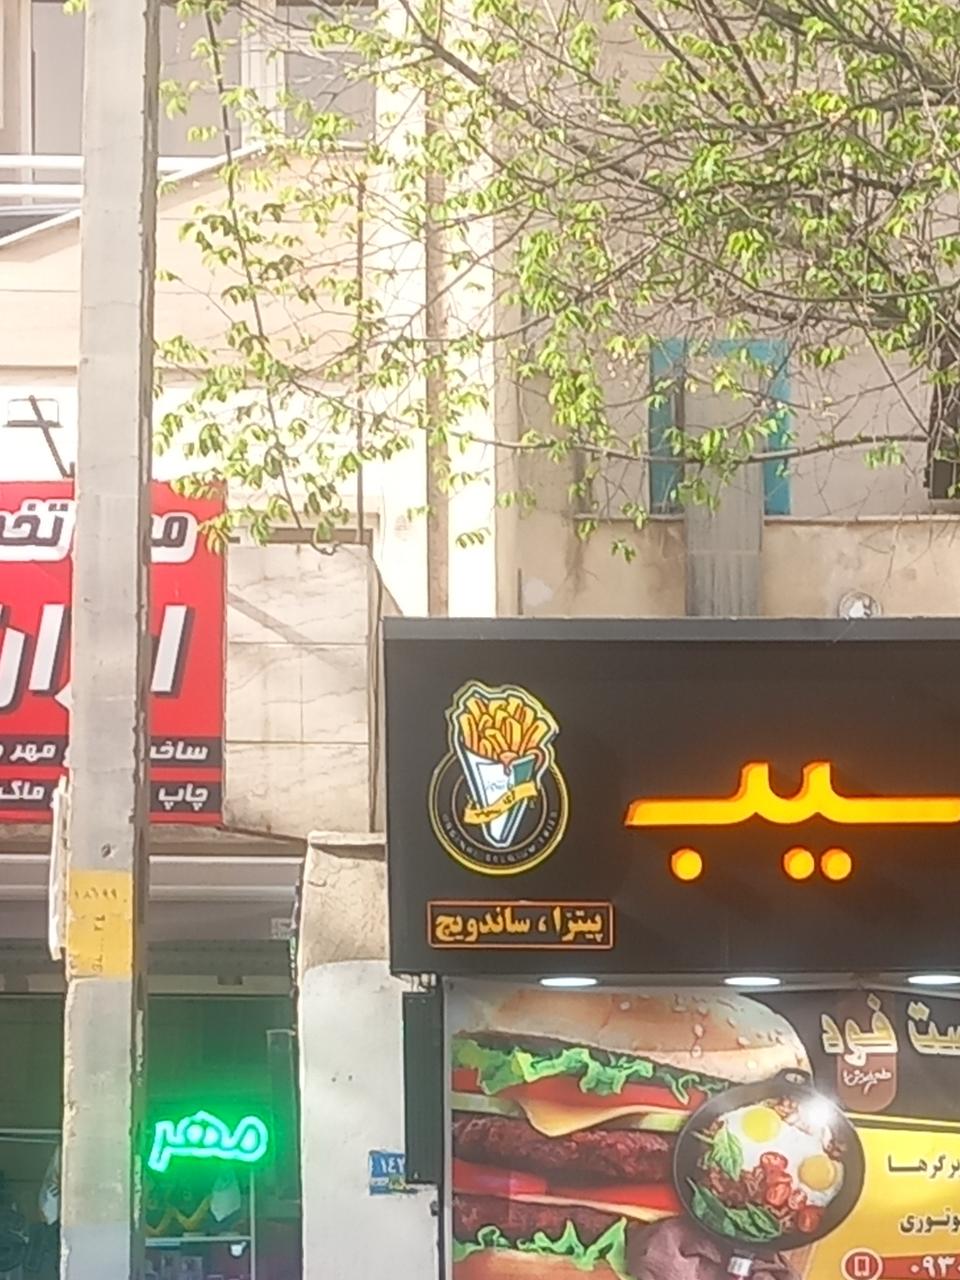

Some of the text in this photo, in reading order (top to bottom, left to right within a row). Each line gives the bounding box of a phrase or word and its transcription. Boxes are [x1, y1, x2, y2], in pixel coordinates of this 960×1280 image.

[159, 783, 208, 811] چاپ
[435, 906, 530, 942] ساندویچ
[553, 906, 603, 942] پیتزا
[821, 993, 898, 1066] فود
[148, 1110, 269, 1172] مهر
